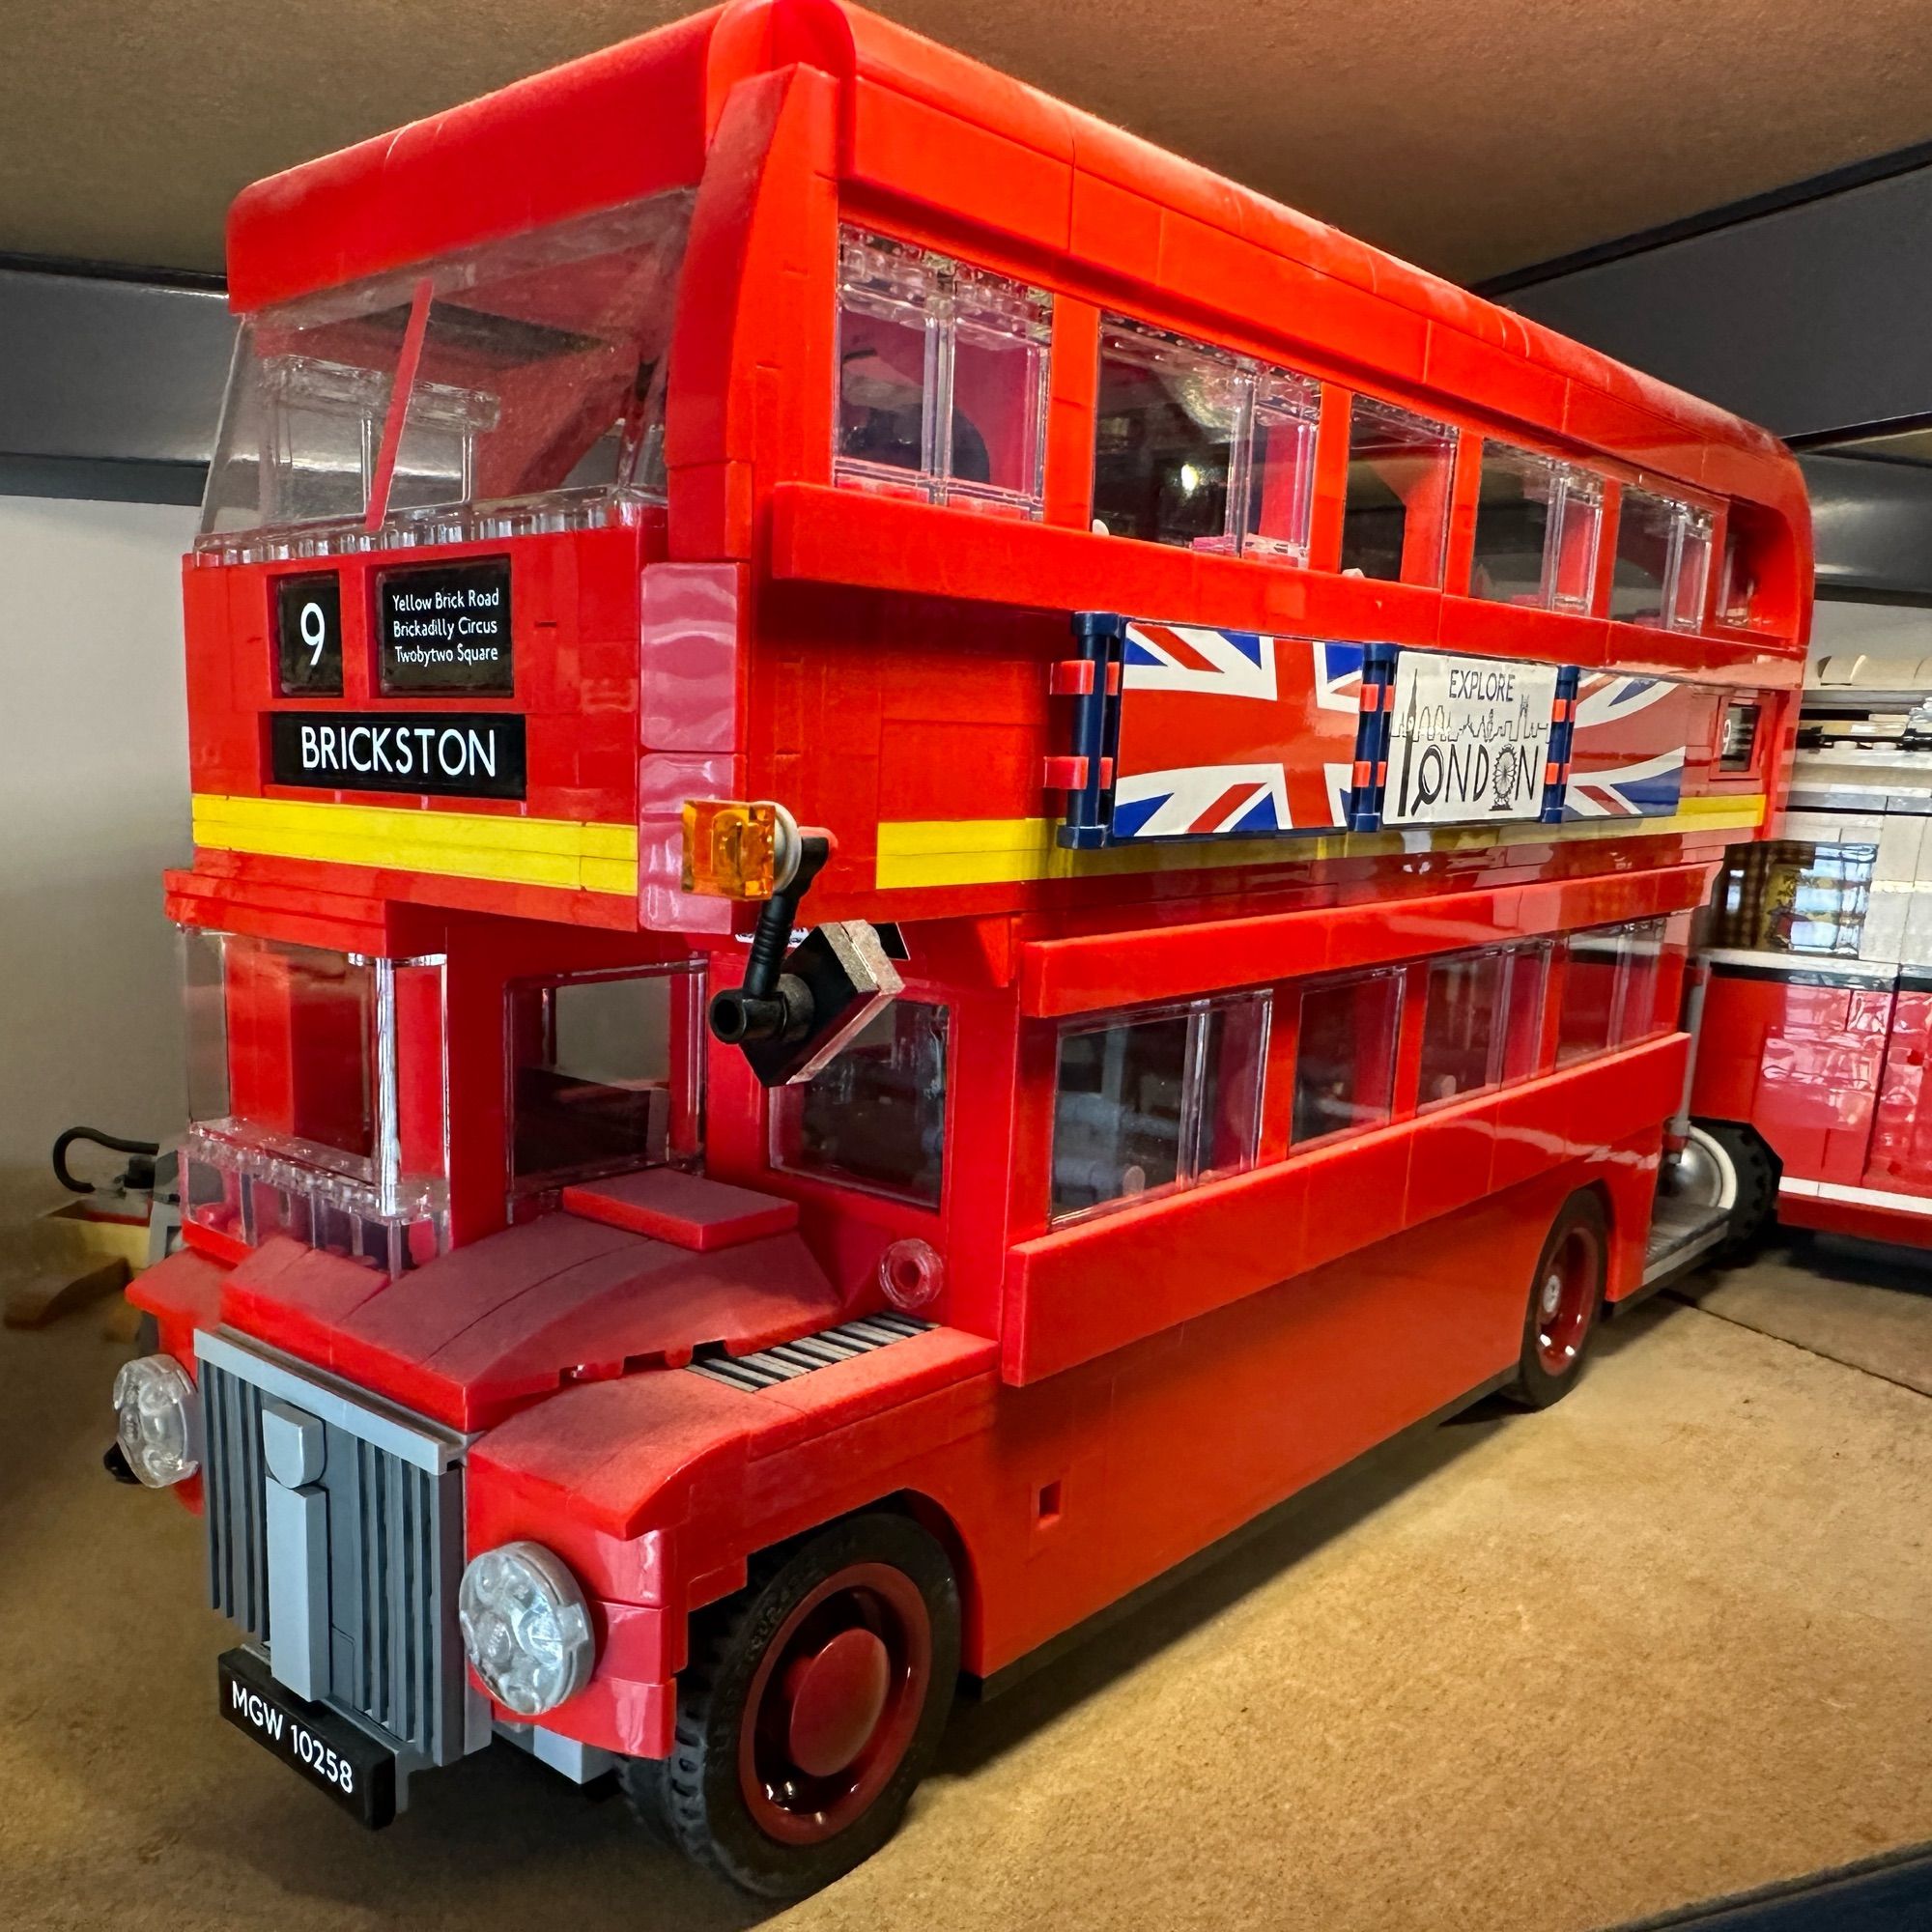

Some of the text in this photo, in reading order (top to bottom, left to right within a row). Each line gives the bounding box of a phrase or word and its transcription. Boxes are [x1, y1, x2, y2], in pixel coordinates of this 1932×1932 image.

[392, 587, 499, 611] Yellow Brick Road
[300, 602, 326, 666] 9
[393, 616, 497, 639] Brickadilly Circus
[395, 643, 498, 668] Twobytwo Square
[1449, 669, 1516, 702] EXPLORE
[300, 726, 496, 777] BRICKSTON
[232, 1680, 354, 1794] MGW 10258
